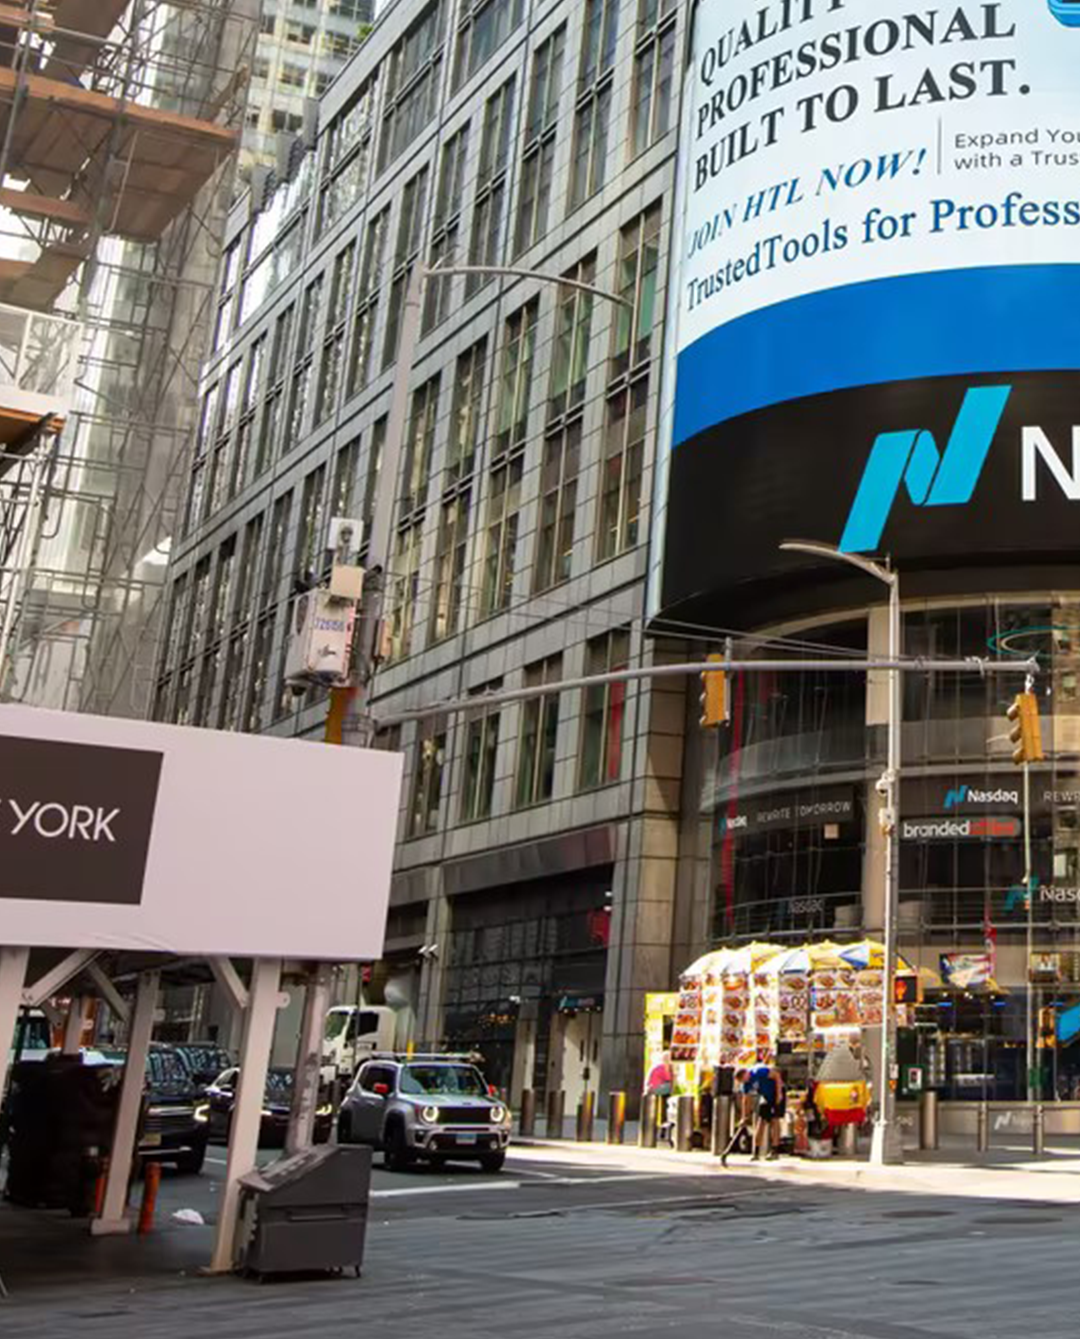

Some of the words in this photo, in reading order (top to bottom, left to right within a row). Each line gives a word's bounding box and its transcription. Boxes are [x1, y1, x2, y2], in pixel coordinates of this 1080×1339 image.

[696, 3, 1016, 141] PROFESSIONAL
[694, 107, 784, 193] BUILT
[797, 84, 859, 133] TO
[874, 59, 1030, 113] LAST.
[954, 128, 1039, 149] Expand
[954, 151, 1002, 170] with
[1010, 154, 1023, 167] a
[688, 203, 737, 259] JOIN
[743, 176, 803, 223] HTL
[815, 148, 927, 196] NOW!
[861, 207, 916, 244] for
[967, 789, 1019, 806] Nasdaq
[8, 798, 120, 843] YORK
[903, 820, 971, 838] branded
